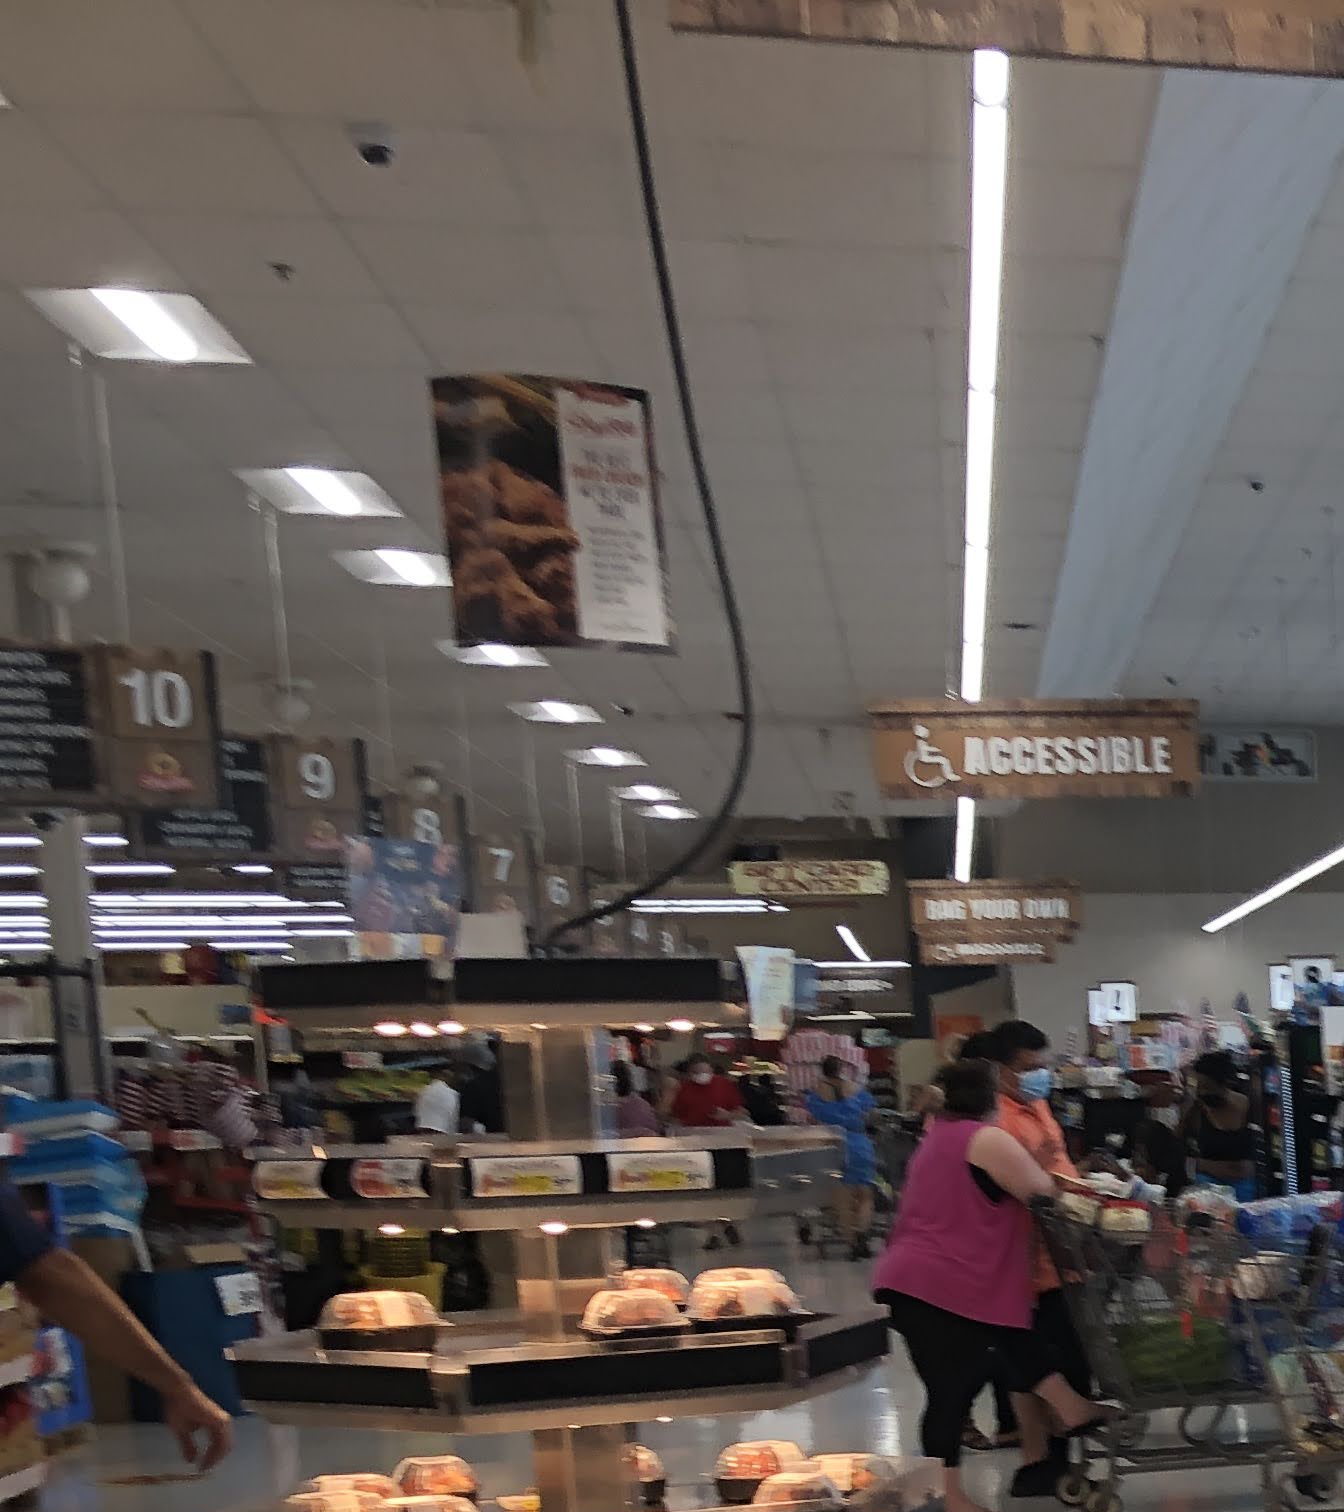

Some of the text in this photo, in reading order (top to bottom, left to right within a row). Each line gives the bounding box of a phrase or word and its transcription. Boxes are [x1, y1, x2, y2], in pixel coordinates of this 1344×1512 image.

[119, 668, 193, 728] 10
[299, 753, 336, 801] 9
[963, 736, 1172, 775] ACCESSIBLE
[488, 849, 514, 882] 7
